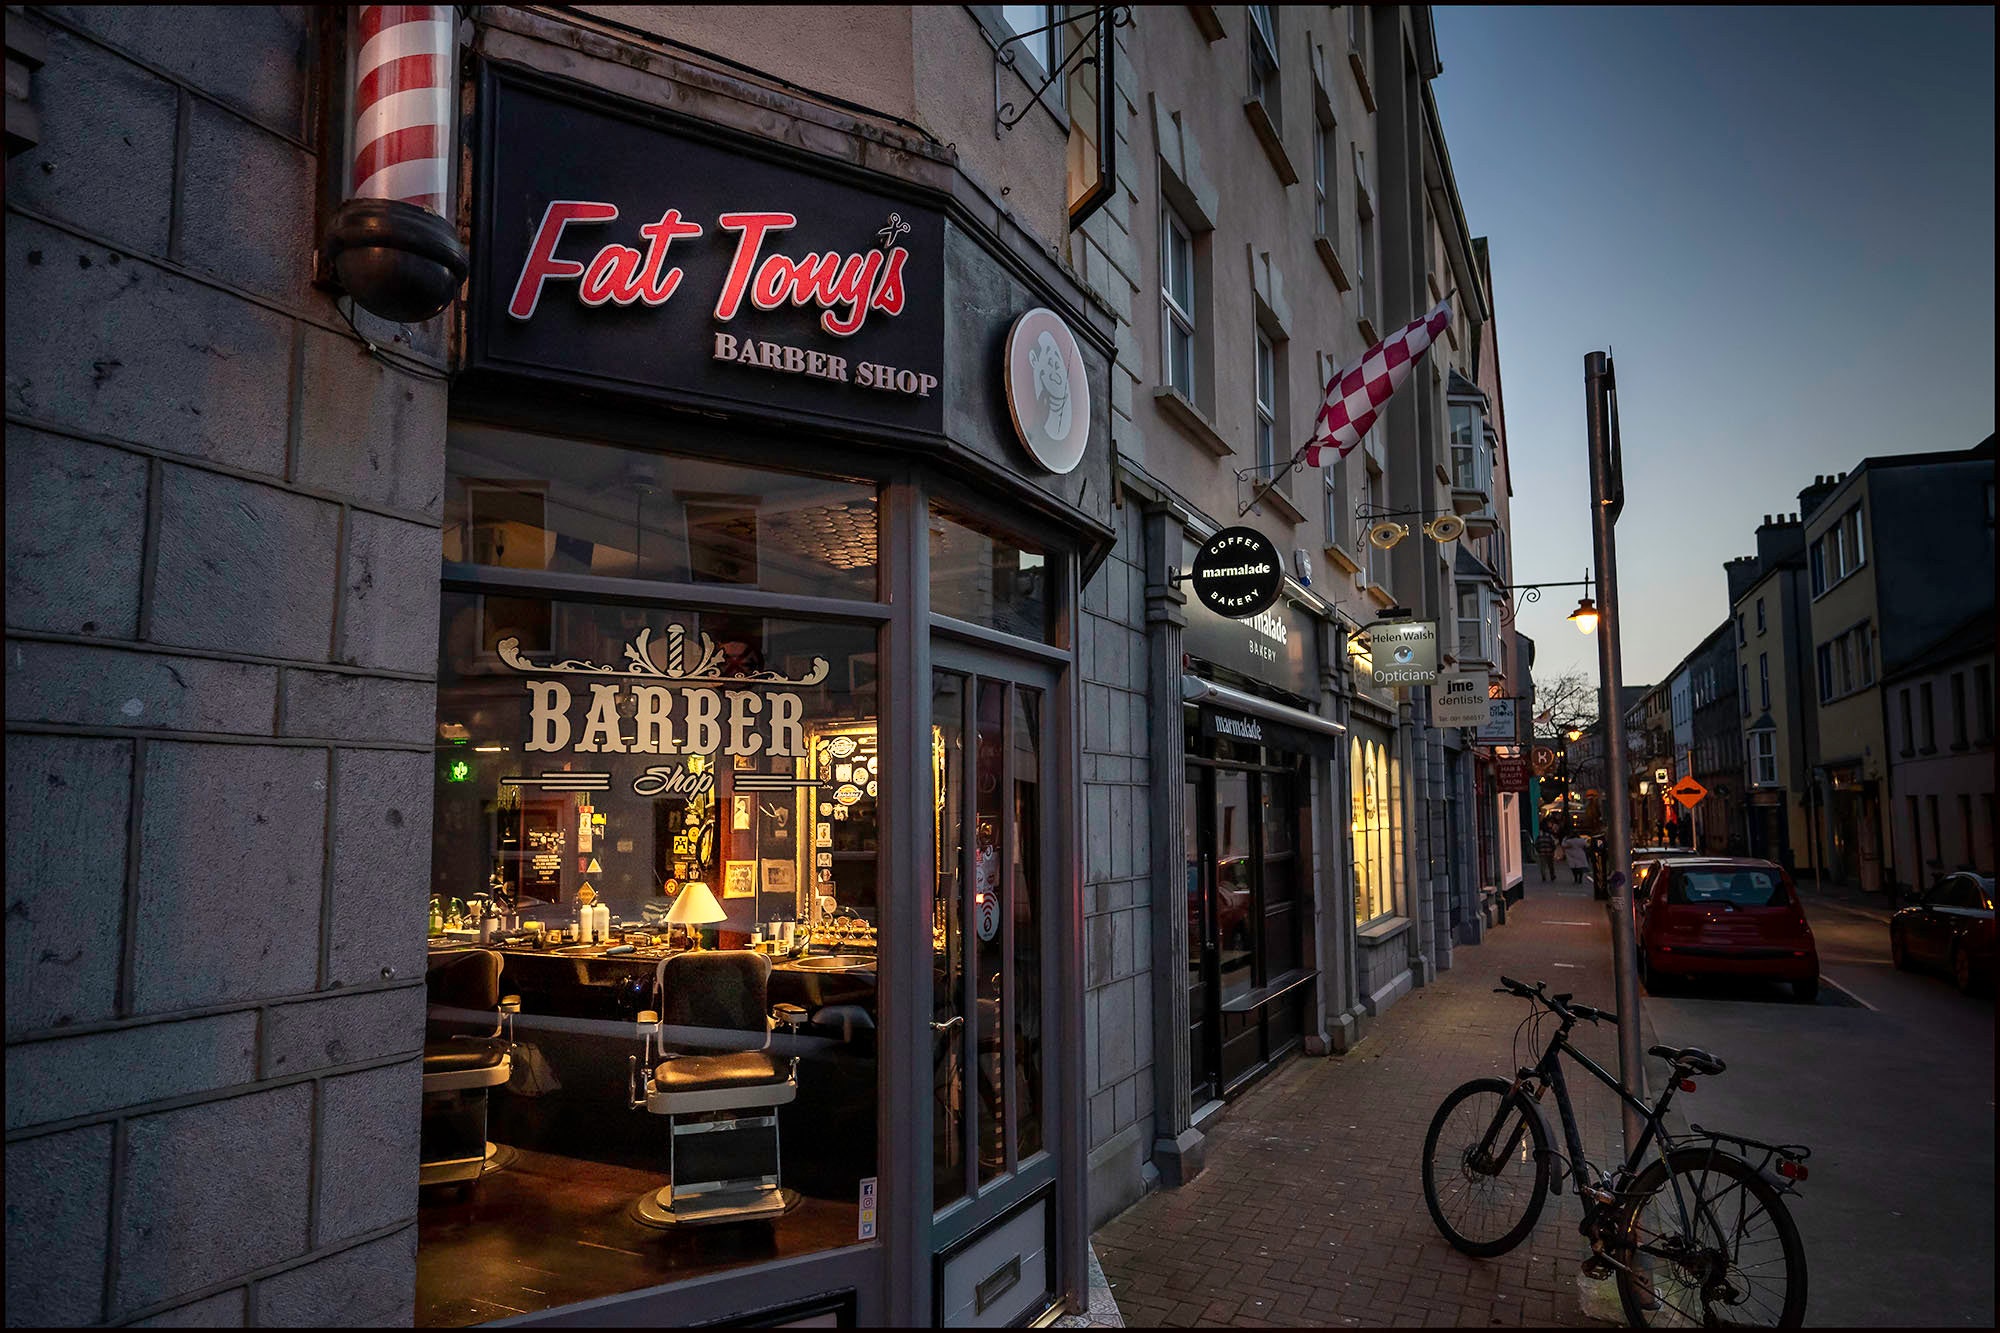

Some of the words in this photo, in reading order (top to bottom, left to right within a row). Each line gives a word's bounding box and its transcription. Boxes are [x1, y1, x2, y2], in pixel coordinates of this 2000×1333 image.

[508, 200, 703, 320] Fat
[714, 212, 911, 336] Tony's
[713, 332, 849, 383] BARBER
[855, 361, 938, 397] SHOP
[1210, 536, 1260, 555] COFFEE
[1202, 562, 1271, 578] marmalade
[1210, 588, 1259, 607] BAKERY
[1237, 609, 1288, 645] rmalade
[1372, 632, 1402, 643] Helen
[1403, 630, 1435, 641] Walsh
[1248, 640, 1277, 663] BAKERY
[1374, 669, 1436, 685] Opticians
[1447, 680, 1475, 695] jme
[1438, 695, 1484, 706] dentists
[525, 680, 808, 758] BARBER
[1215, 714, 1262, 741] marmalade
[633, 764, 714, 801] Shop
